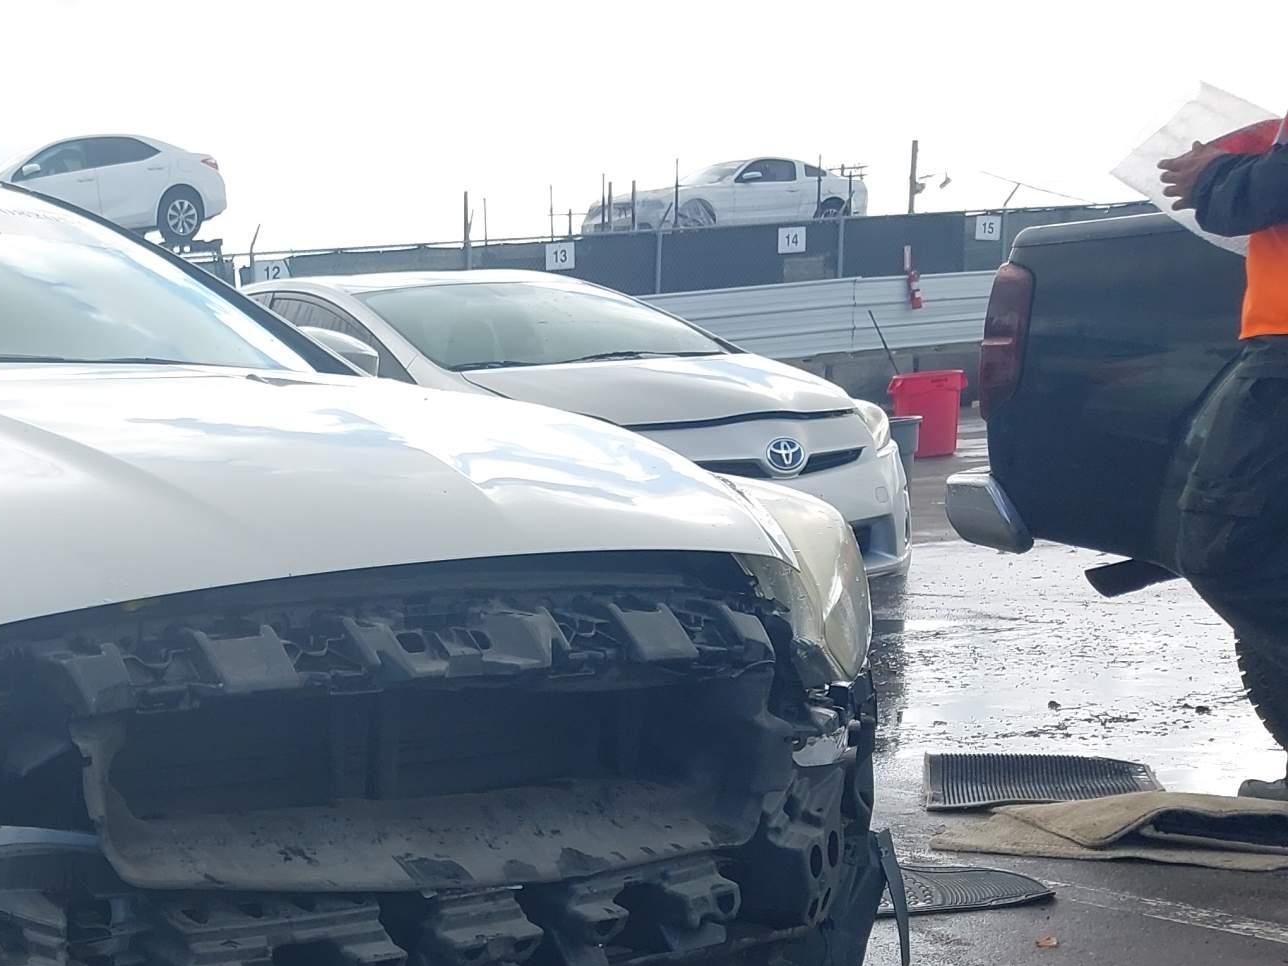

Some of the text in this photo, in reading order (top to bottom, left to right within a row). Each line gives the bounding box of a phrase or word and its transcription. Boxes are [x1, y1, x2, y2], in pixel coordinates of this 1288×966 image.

[982, 221, 994, 234] 15
[785, 233, 798, 247] 14
[553, 249, 567, 263] 13
[264, 265, 280, 280] 12
